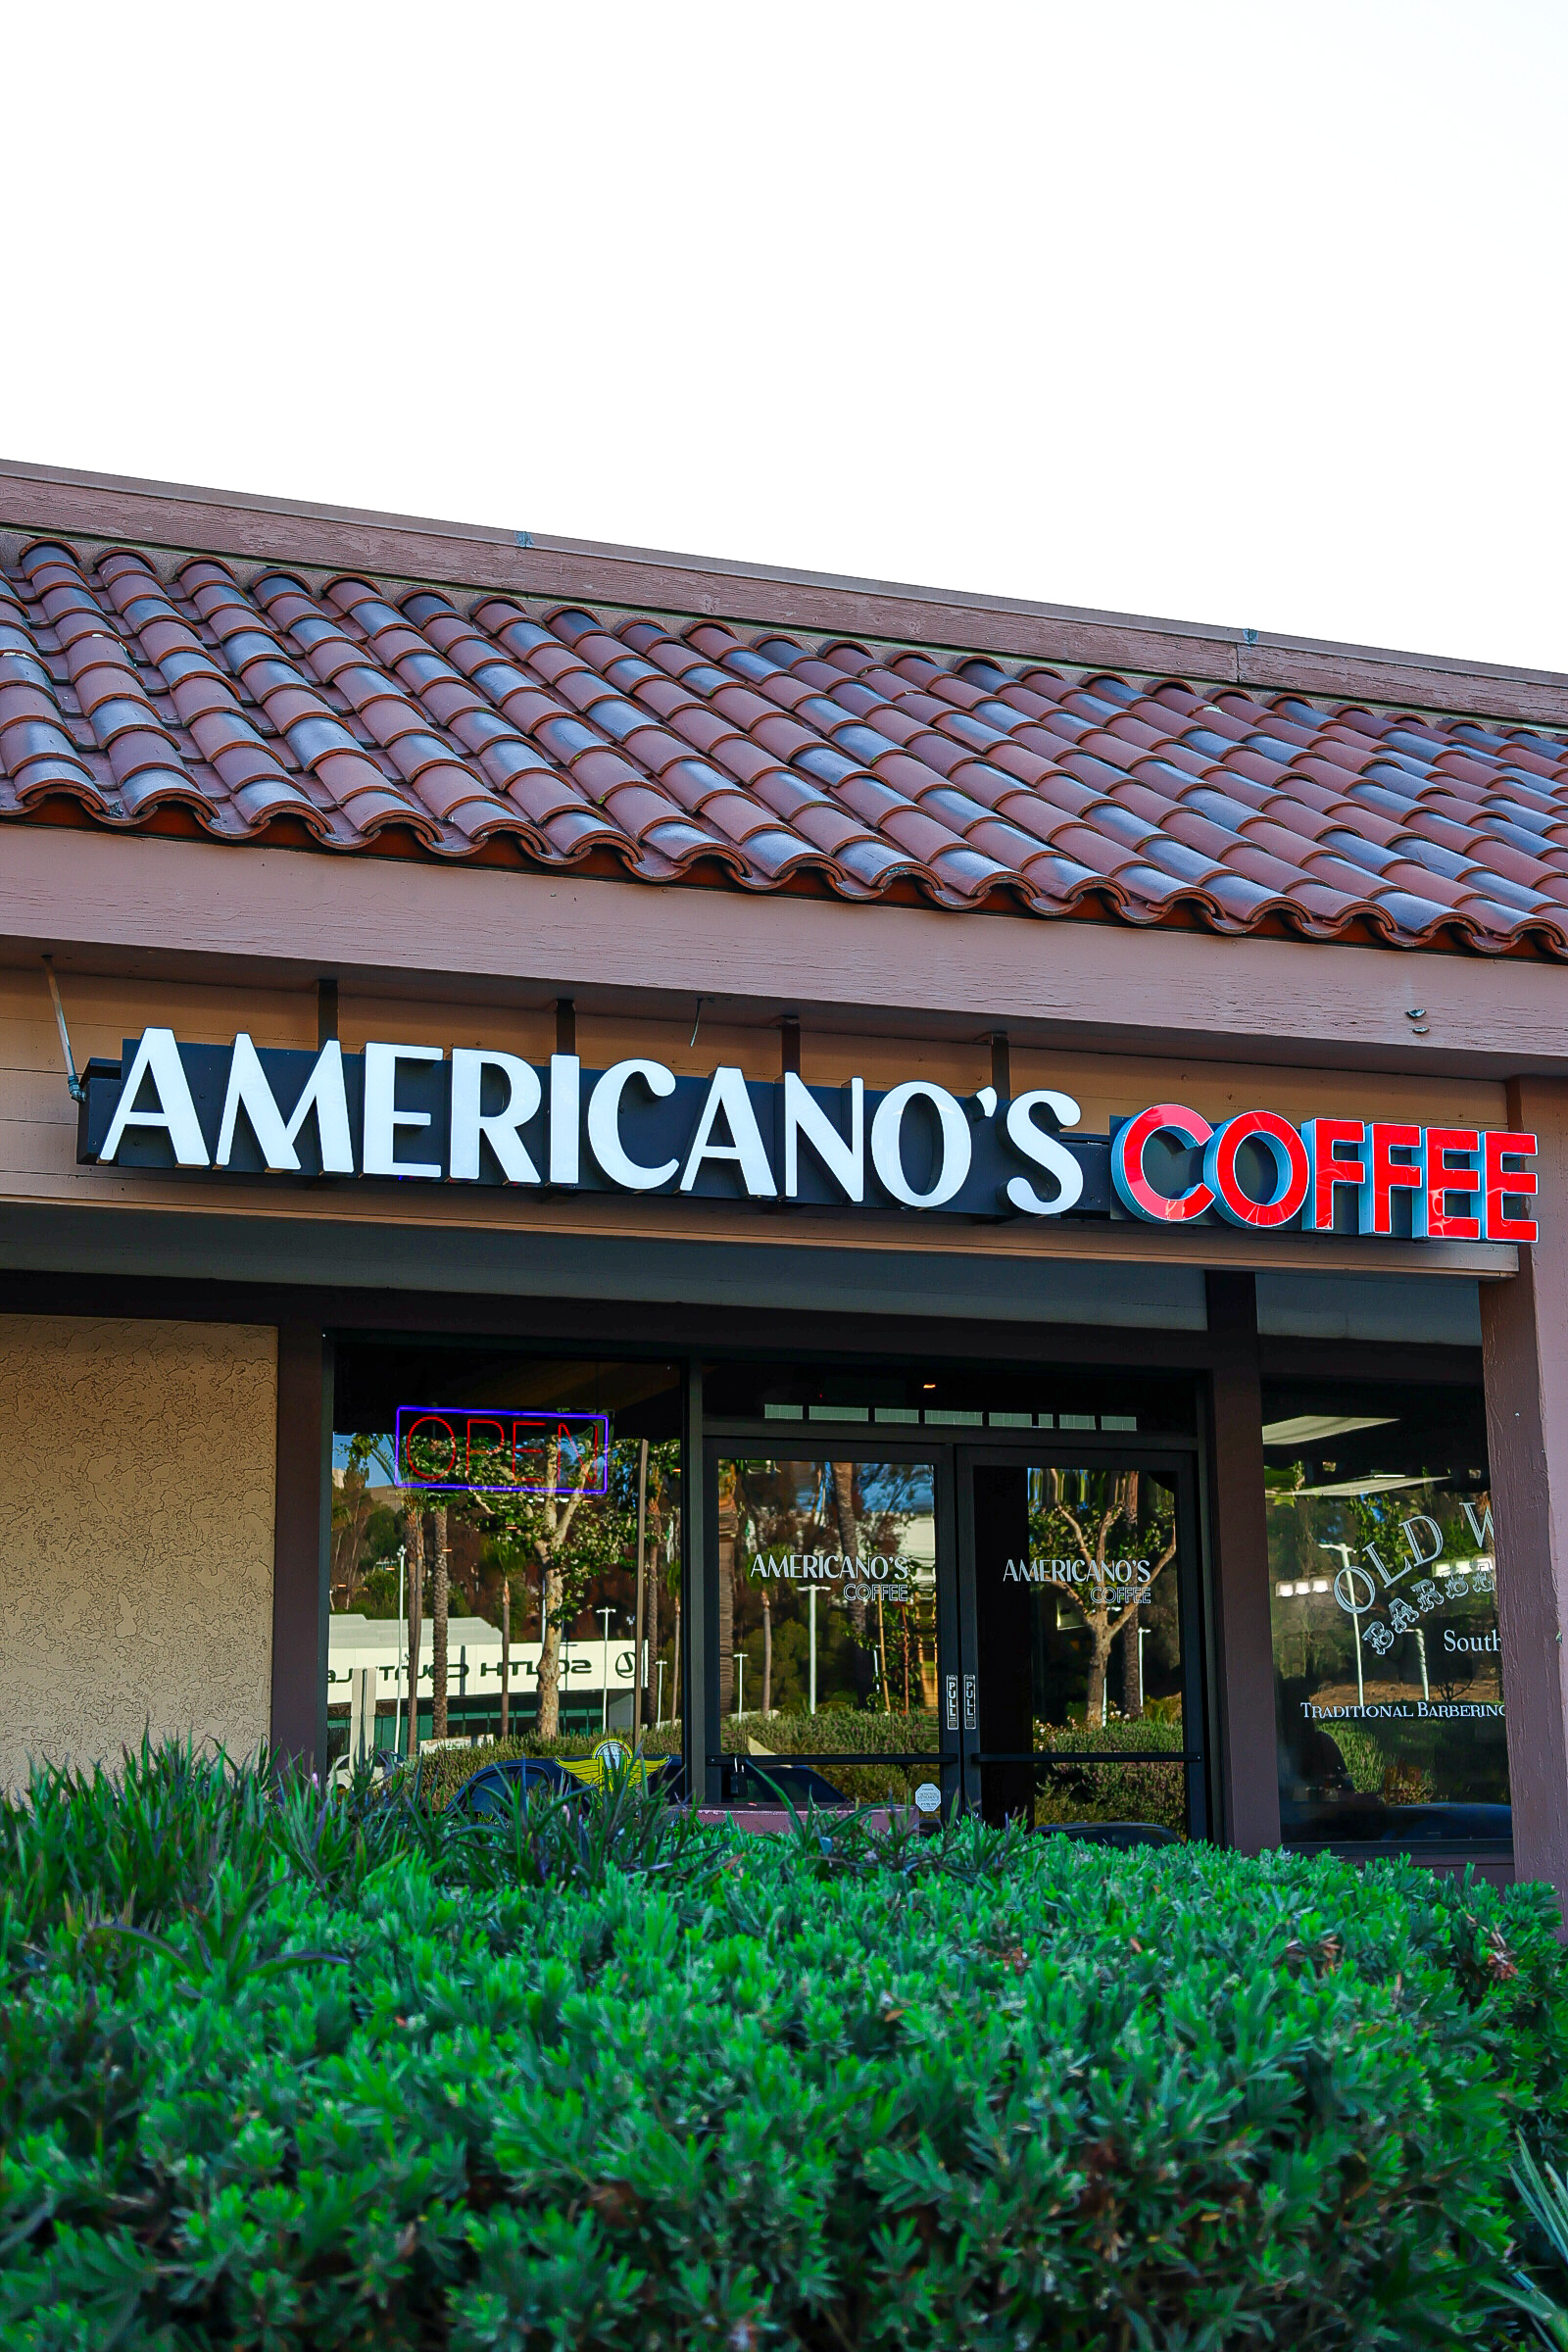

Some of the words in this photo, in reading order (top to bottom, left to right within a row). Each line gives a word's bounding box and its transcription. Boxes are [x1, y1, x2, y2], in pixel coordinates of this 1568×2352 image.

[98, 1026, 1084, 1214] AMERICANO'S
[1112, 1103, 1539, 1244] COFFEE
[406, 1415, 599, 1485] OPEN
[750, 1553, 909, 1580] AMERICANO'S
[1003, 1558, 1152, 1583] AMERICANO'S
[1333, 1515, 1444, 1614] OLD
[843, 1583, 909, 1602] COFFEE
[1090, 1586, 1152, 1604] COFFEE
[948, 1681, 956, 1717] PULL
[965, 1681, 974, 1716] PULL
[1299, 1701, 1414, 1719] TRADITIONAL
